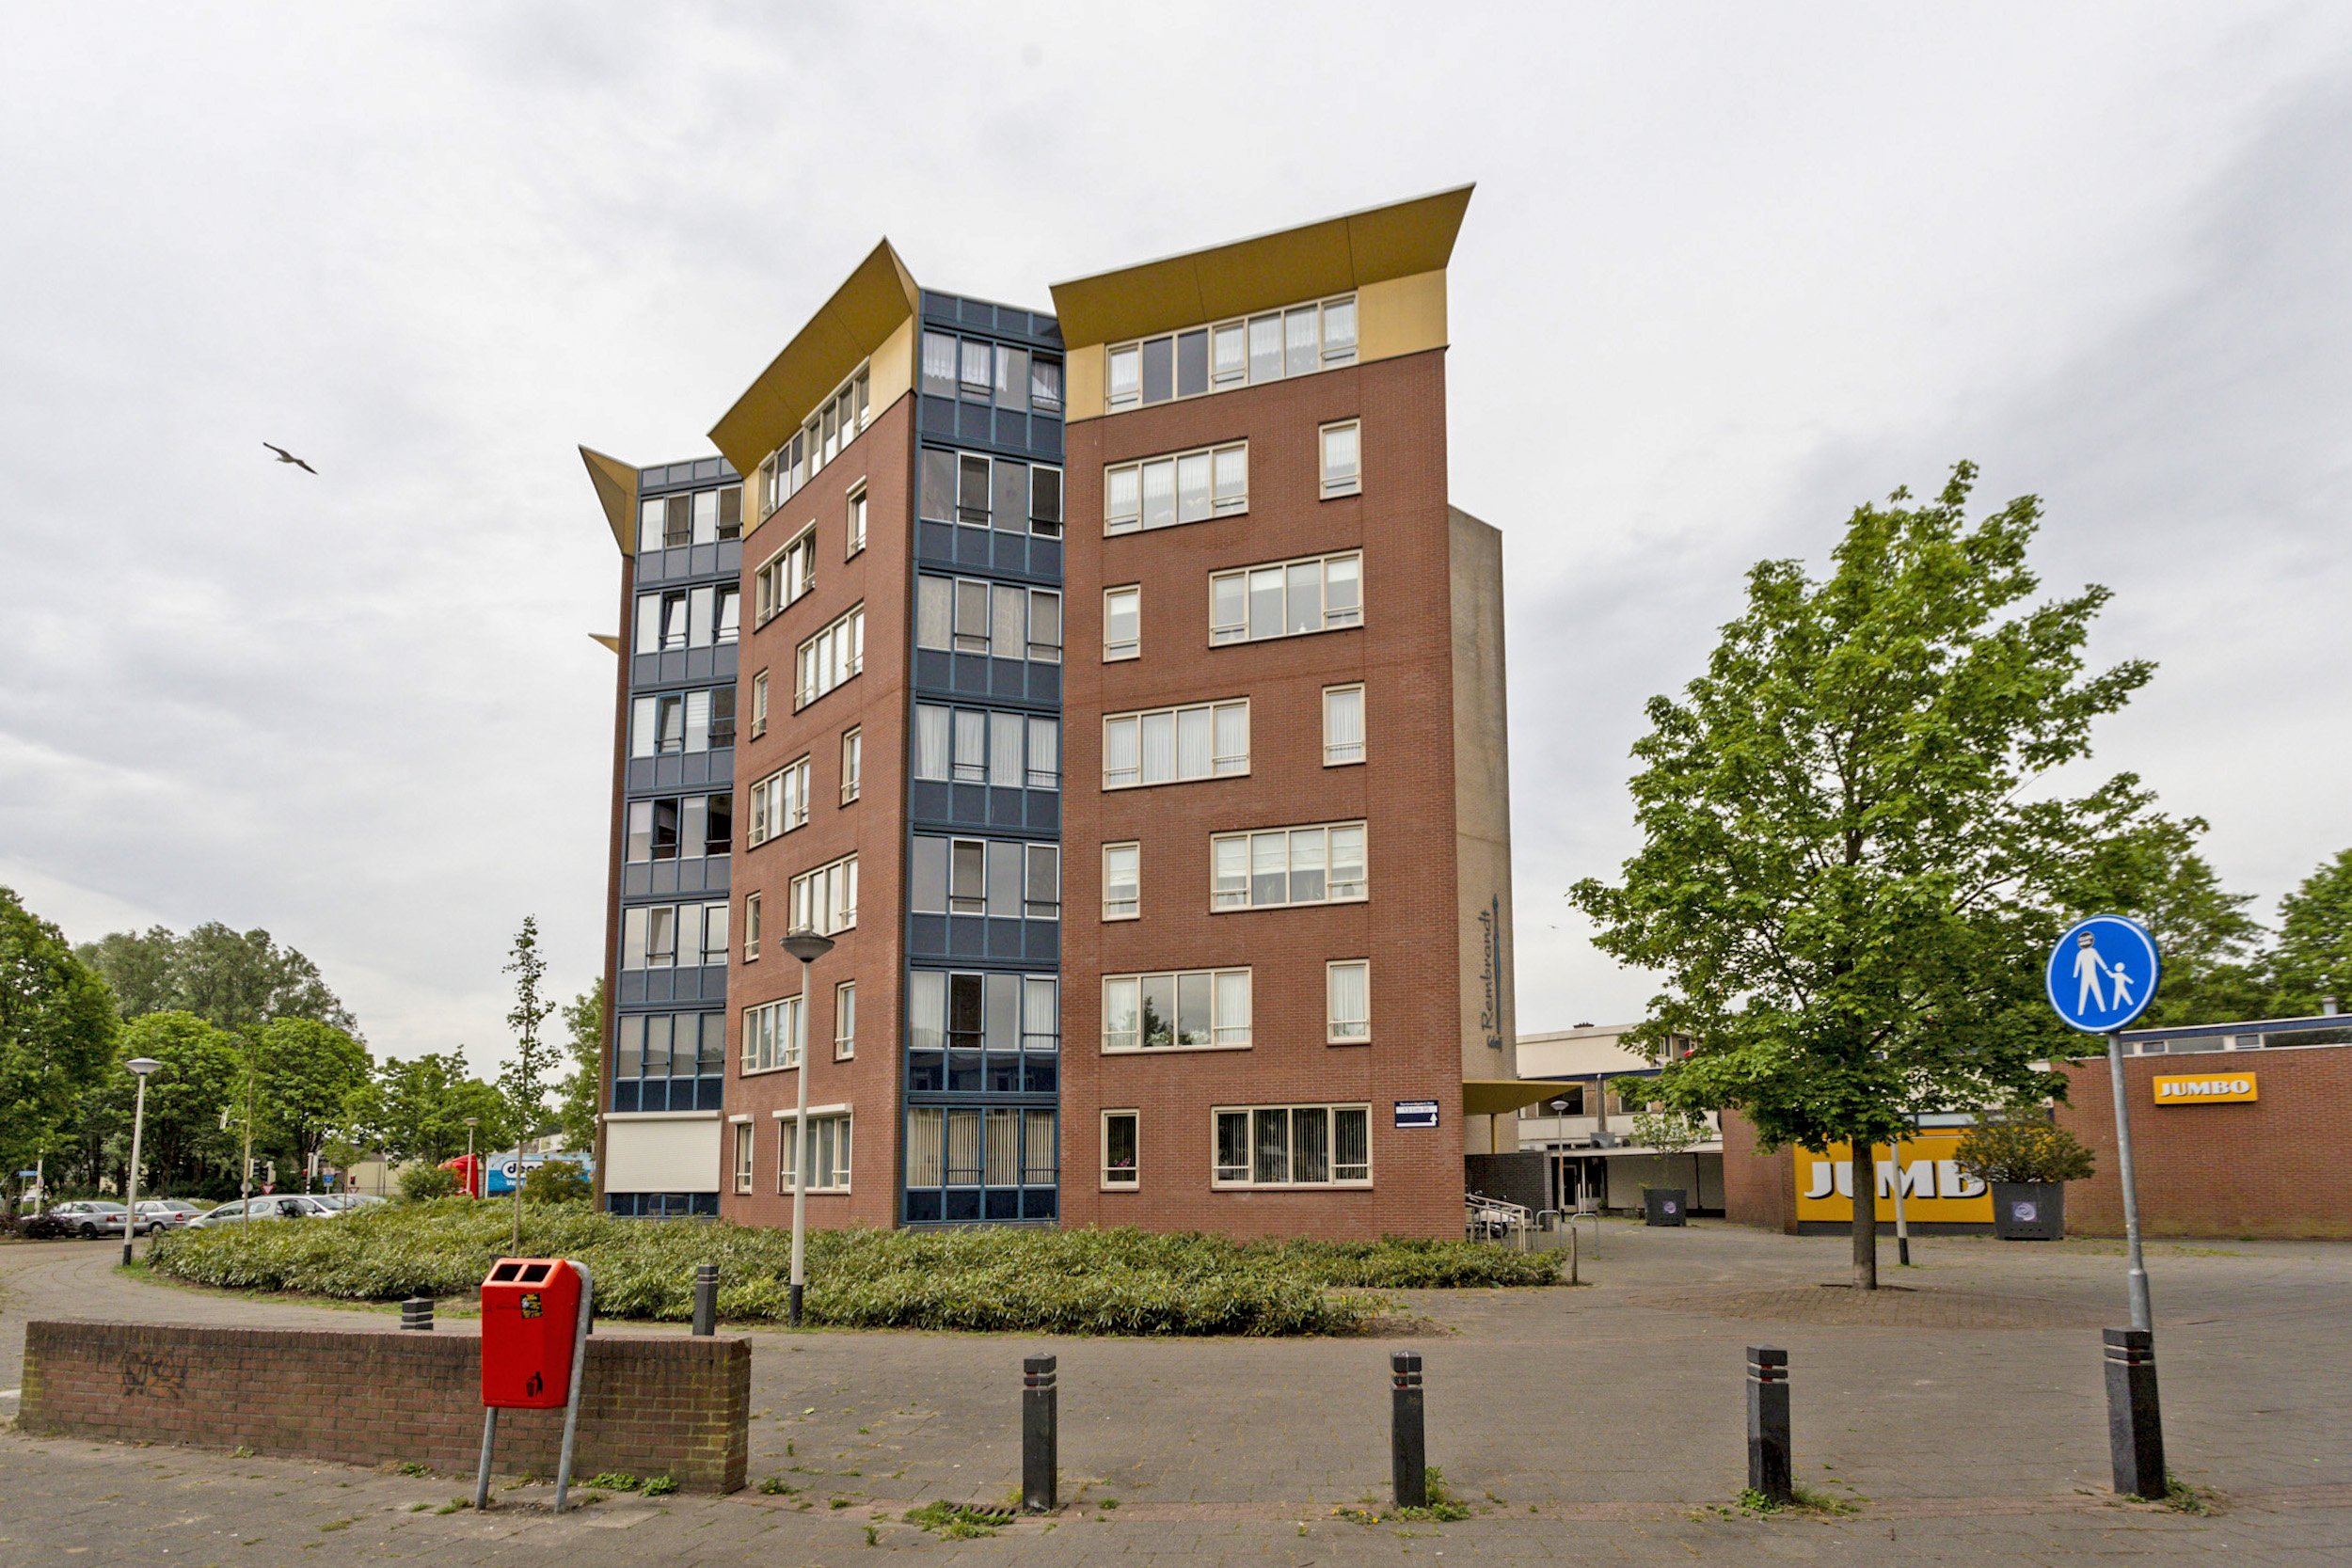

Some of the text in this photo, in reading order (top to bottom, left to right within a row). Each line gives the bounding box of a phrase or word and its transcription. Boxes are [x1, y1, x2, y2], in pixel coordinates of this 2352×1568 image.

[1478, 910, 1492, 1031] Rembrandt
[2160, 1079, 2251, 1097] JUMBO
[1804, 1159, 2010, 1199] JUMB
